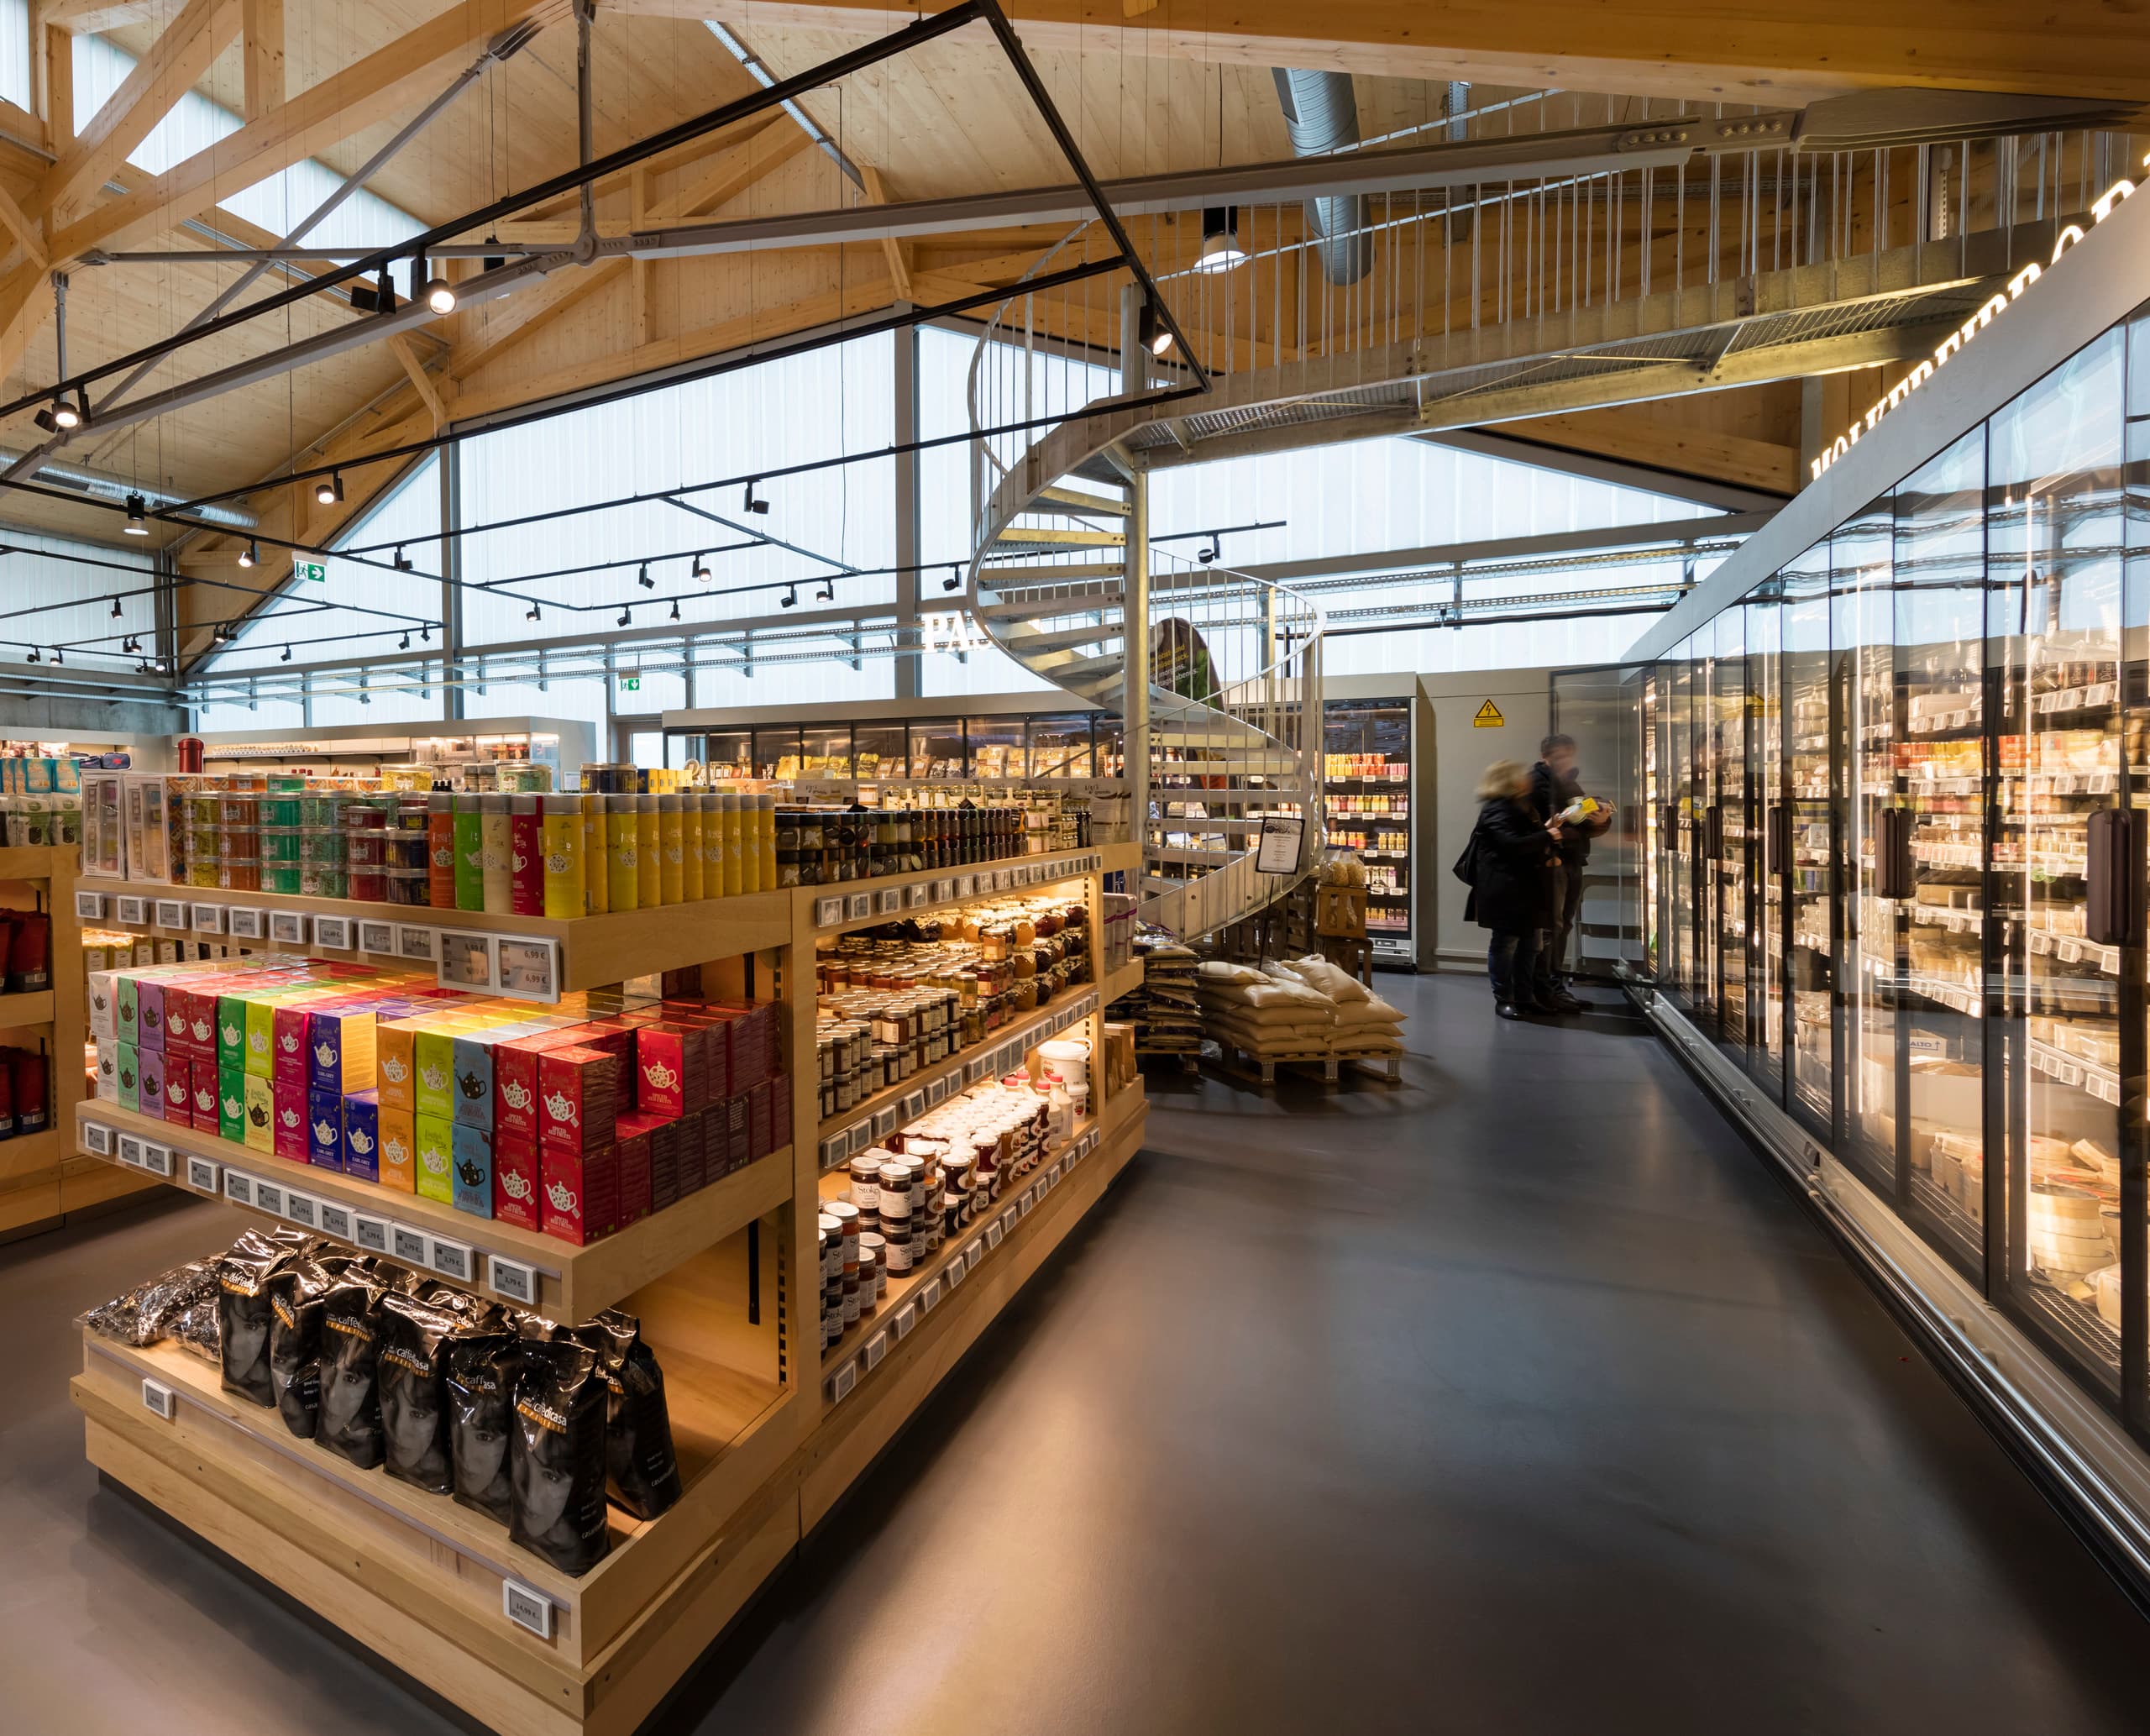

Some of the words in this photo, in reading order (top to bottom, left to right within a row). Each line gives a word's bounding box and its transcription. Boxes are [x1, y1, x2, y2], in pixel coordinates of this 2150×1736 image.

[524, 950, 539, 959] 6,99
[540, 951, 546, 960] €
[525, 974, 540, 983] 6,99
[541, 976, 547, 984] €
